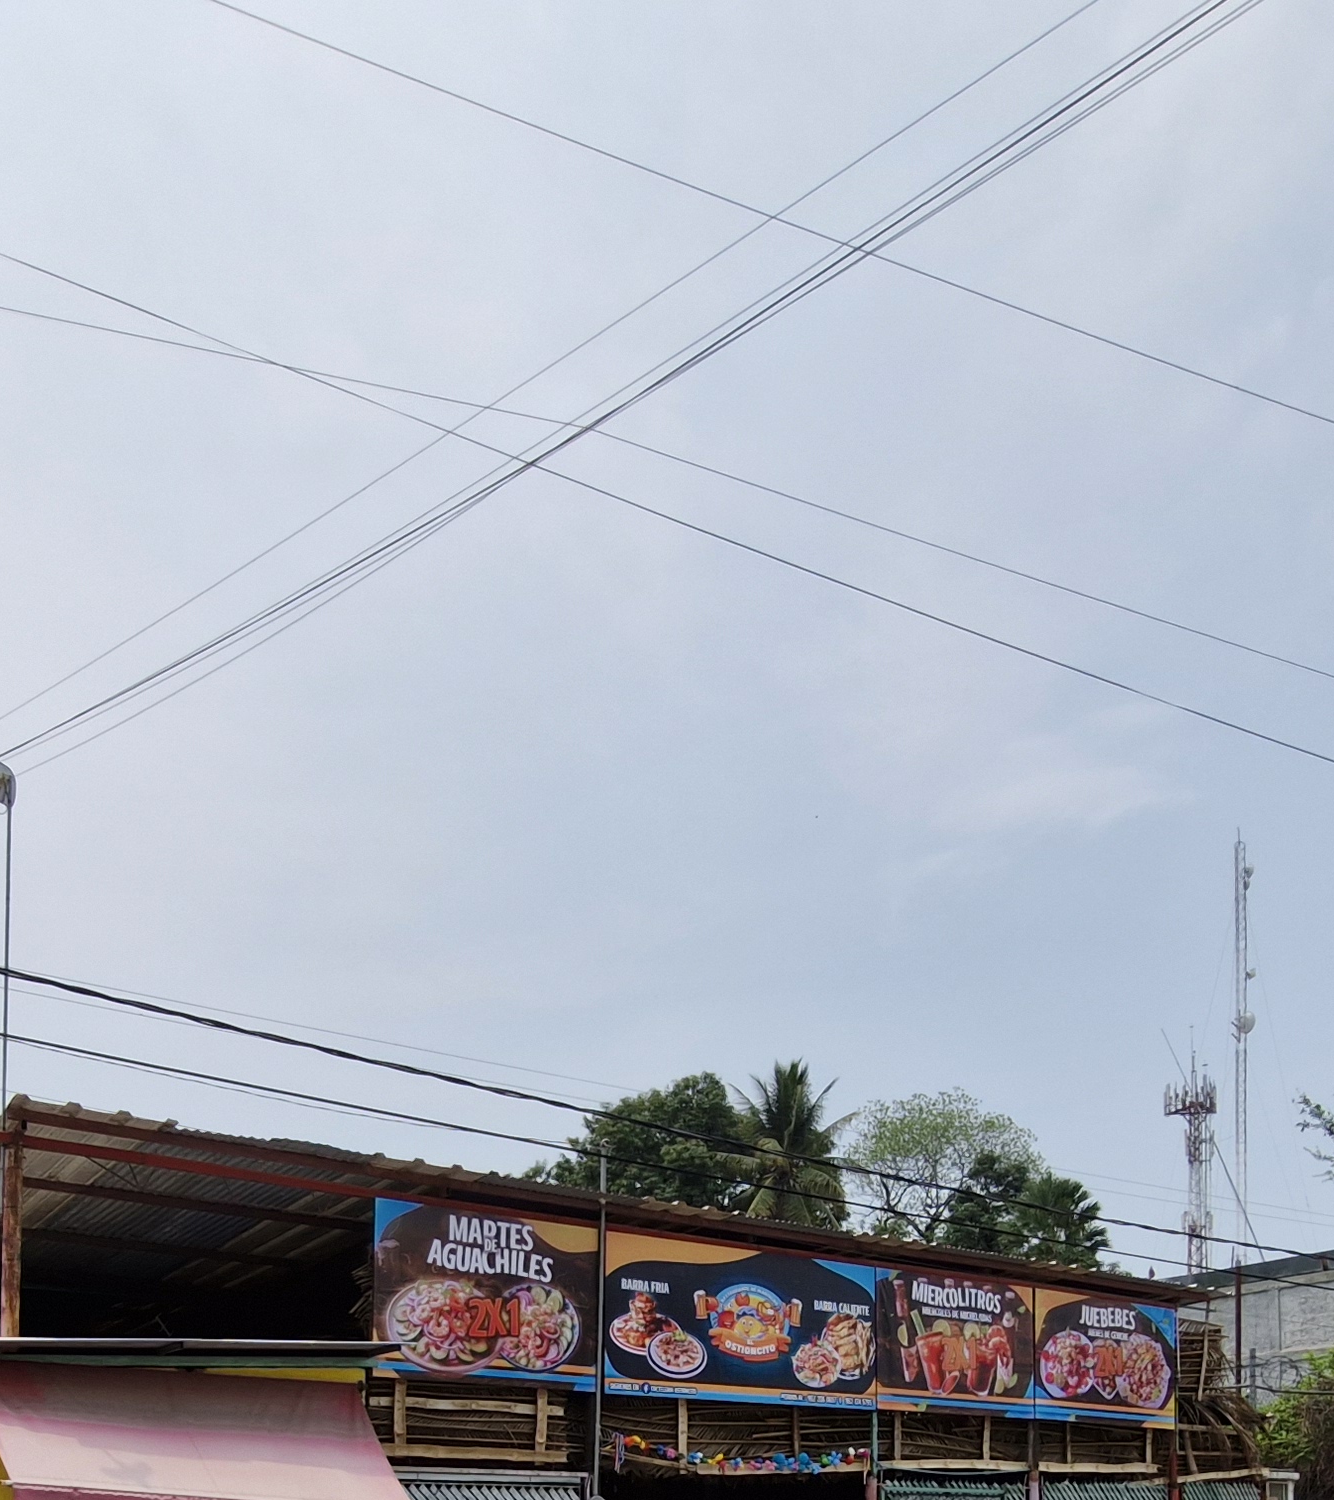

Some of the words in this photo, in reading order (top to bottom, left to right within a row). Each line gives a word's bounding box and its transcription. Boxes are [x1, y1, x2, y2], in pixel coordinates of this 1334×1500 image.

[449, 1214, 534, 1251] MARTES
[484, 1238, 498, 1253] DE
[427, 1239, 554, 1283] AGUACHILES
[621, 1278, 649, 1293] BARRA
[650, 1281, 670, 1295] FRIA
[911, 1280, 1001, 1314] MIERCOLITROS
[468, 1297, 520, 1338] 2X1
[814, 1299, 837, 1313] BARRA
[838, 1302, 870, 1317] CALIENTE
[1079, 1304, 1136, 1330] JUEBEBES
[725, 1340, 776, 1355] OSTIONCITO
[941, 1336, 977, 1371] 2X1
[1094, 1346, 1123, 1377] 2X1
